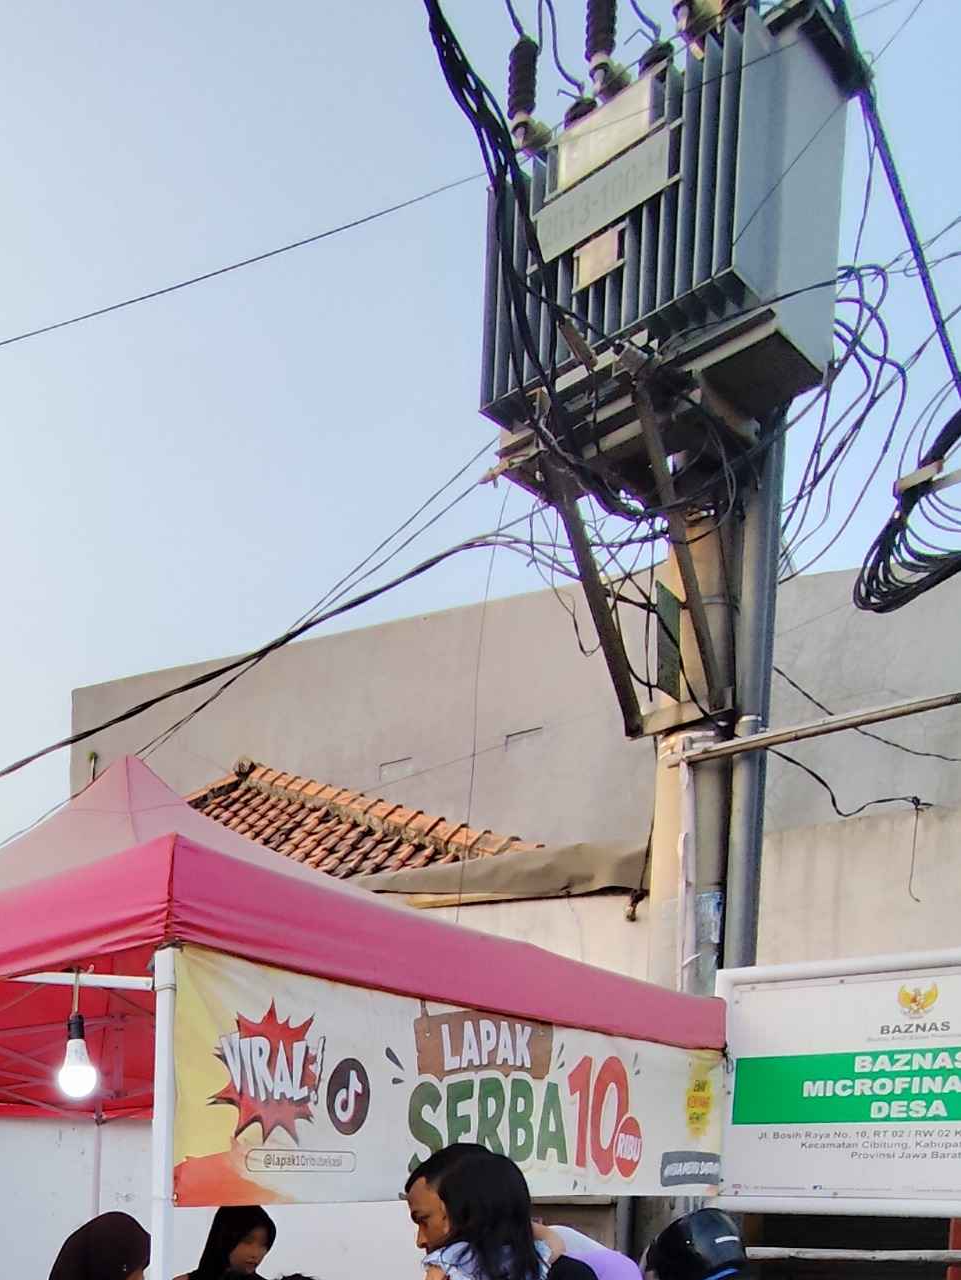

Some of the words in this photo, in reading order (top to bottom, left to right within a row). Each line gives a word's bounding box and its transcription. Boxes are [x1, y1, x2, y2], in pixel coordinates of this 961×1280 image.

[880, 1020, 951, 1035] BAZNAS
[441, 1020, 532, 1071] LAPAK
[219, 1031, 326, 1105] VIRAL!
[408, 1076, 568, 1172] SERBA
[568, 1055, 630, 1176] 10
[870, 1099, 948, 1118] DESA
[805, 1130, 831, 1140] Raya
[873, 1129, 889, 1138] RT
[915, 1128, 935, 1137] RW
[617, 1132, 642, 1163] RIBU
[801, 1141, 858, 1149] Kecamatan
[851, 1151, 895, 1160] Provinsi
[899, 1151, 927, 1160] Jawa
